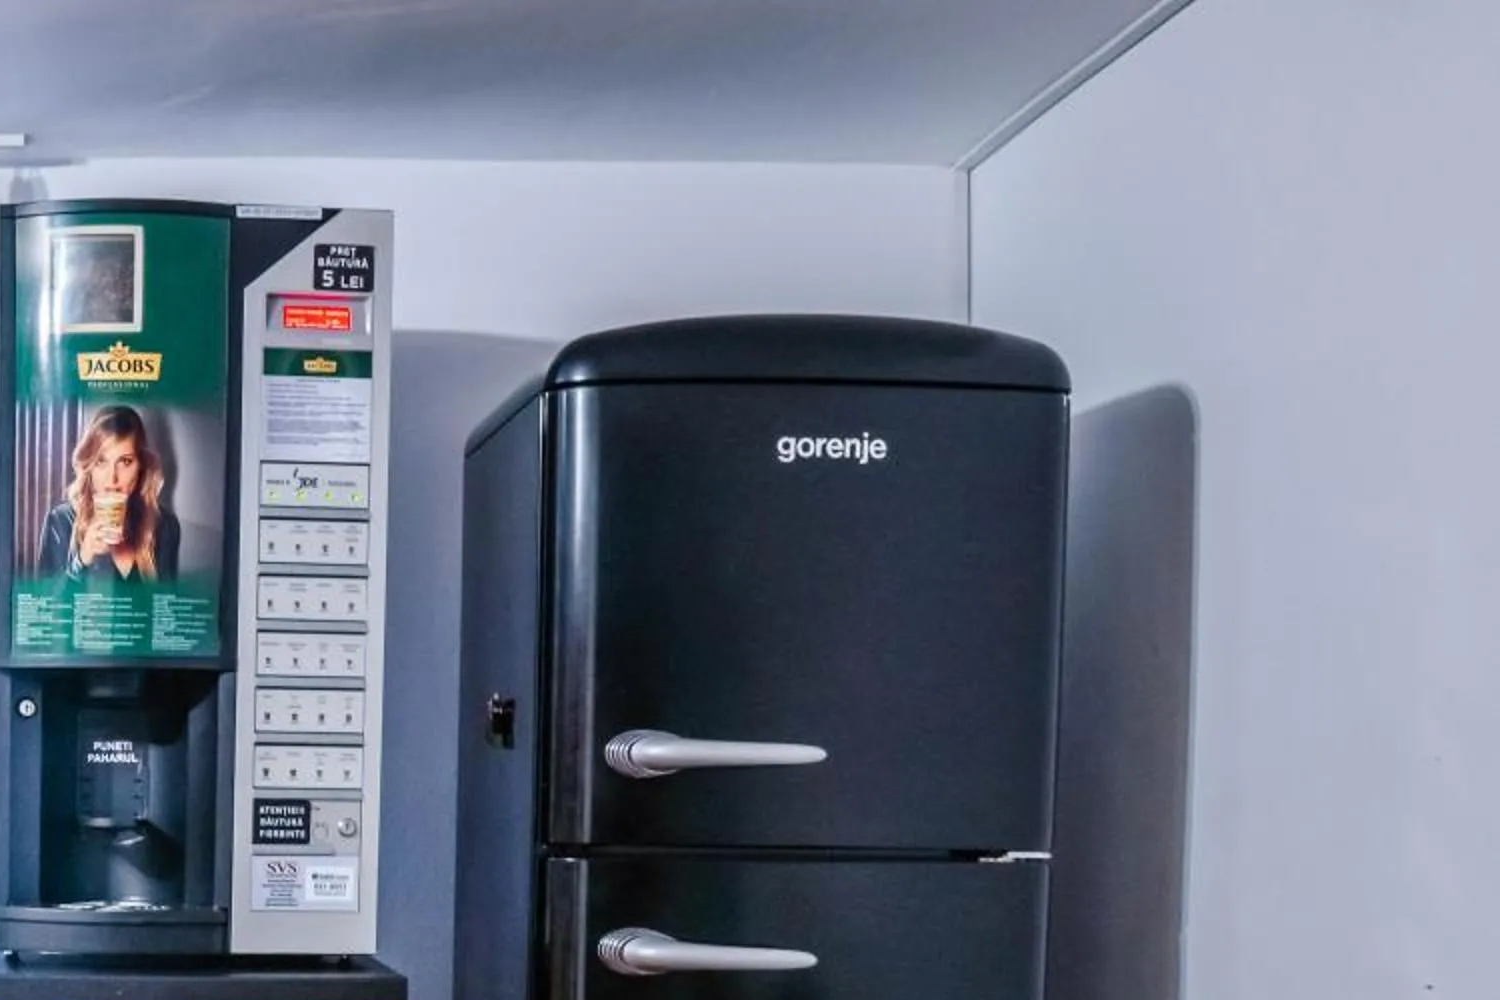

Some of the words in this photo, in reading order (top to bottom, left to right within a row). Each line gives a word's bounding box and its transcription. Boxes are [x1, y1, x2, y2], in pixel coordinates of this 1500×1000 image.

[322, 269, 335, 288] 5
[341, 275, 364, 289] LEI
[86, 359, 154, 375] JACOBS
[776, 432, 888, 465] gorenje
